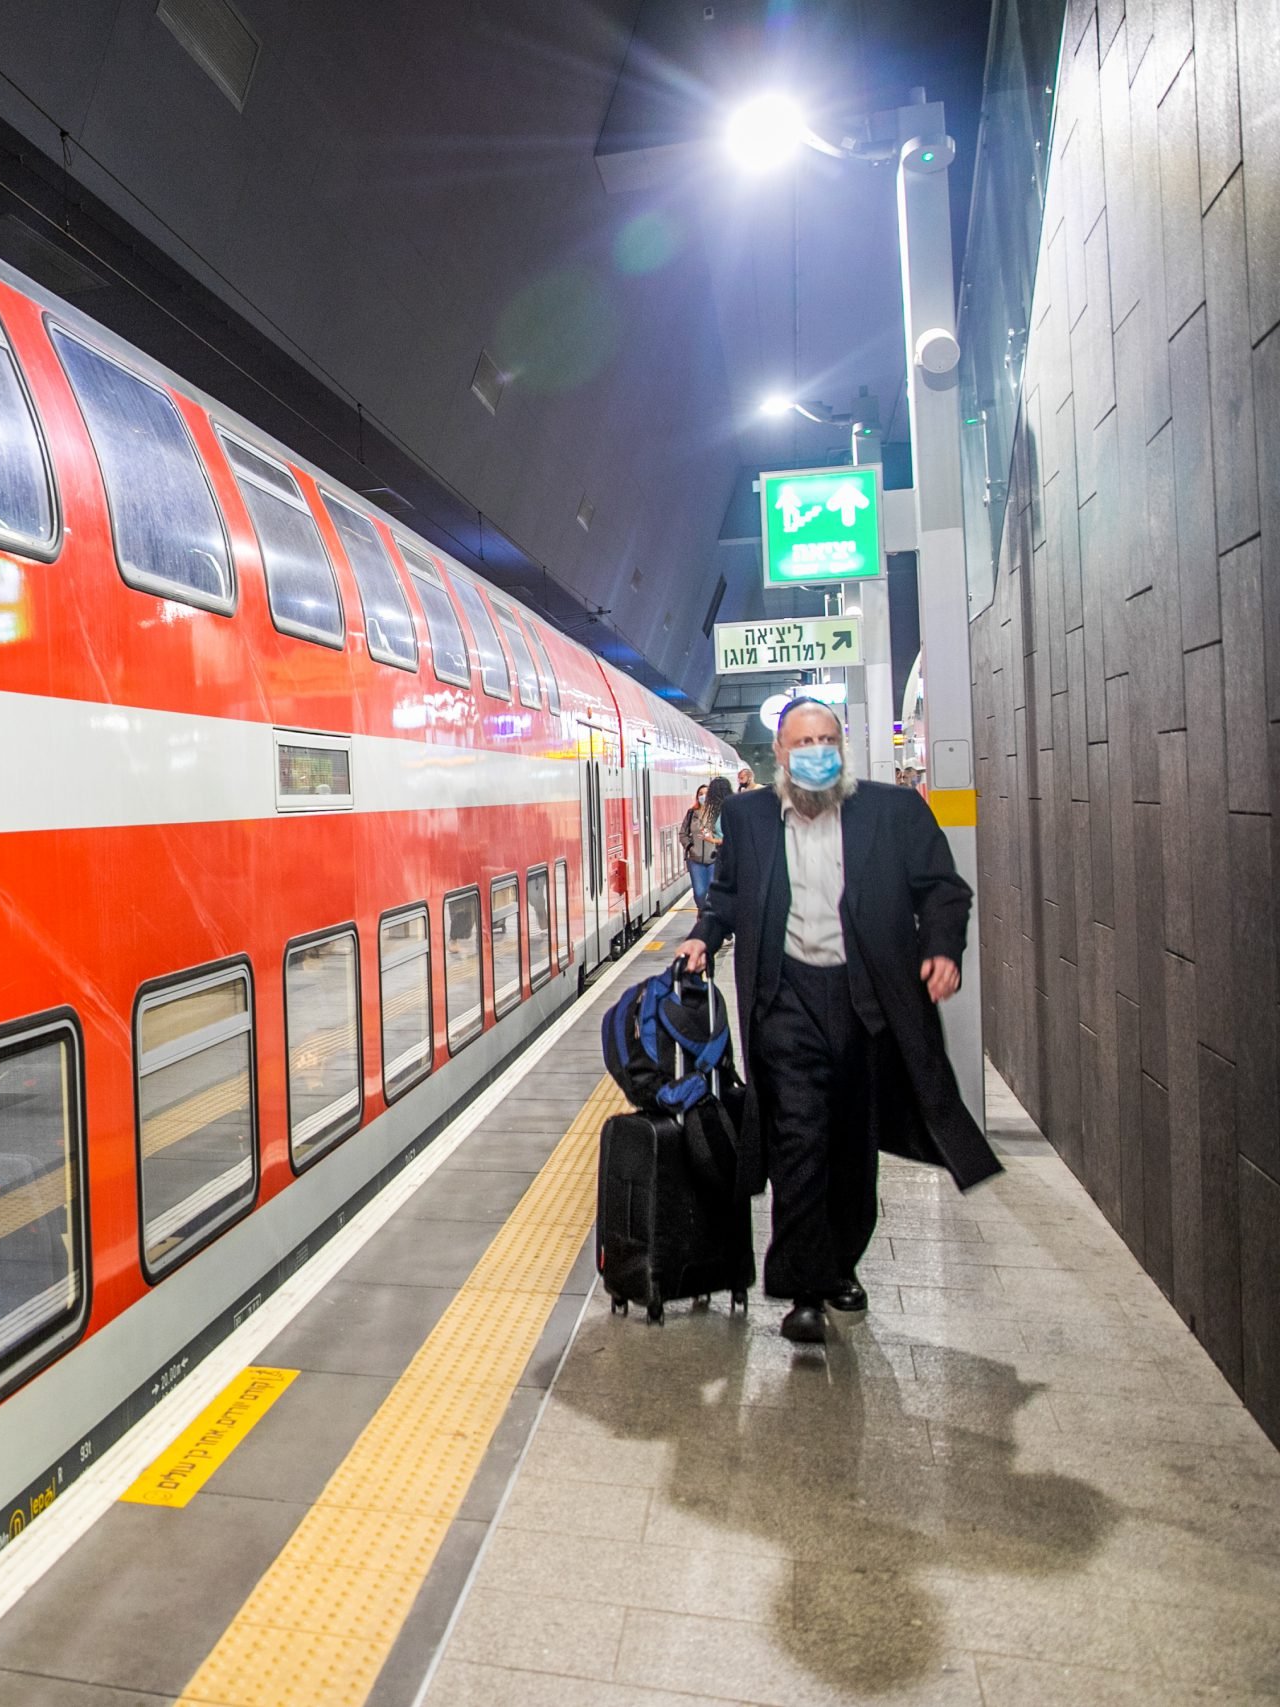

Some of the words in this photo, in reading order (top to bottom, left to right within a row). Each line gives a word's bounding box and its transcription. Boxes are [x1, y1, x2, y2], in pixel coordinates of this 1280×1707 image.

[745, 624, 803, 646] ליציאה
[724, 648, 758, 668] מוגן
[767, 641, 826, 663] למרחב
[240, 1381, 275, 1400] קודם
[195, 1429, 228, 1446] אחר
[80, 1440, 92, 1462] 93t
[184, 1449, 213, 1459] כך
[157, 1461, 196, 1489] עולים
